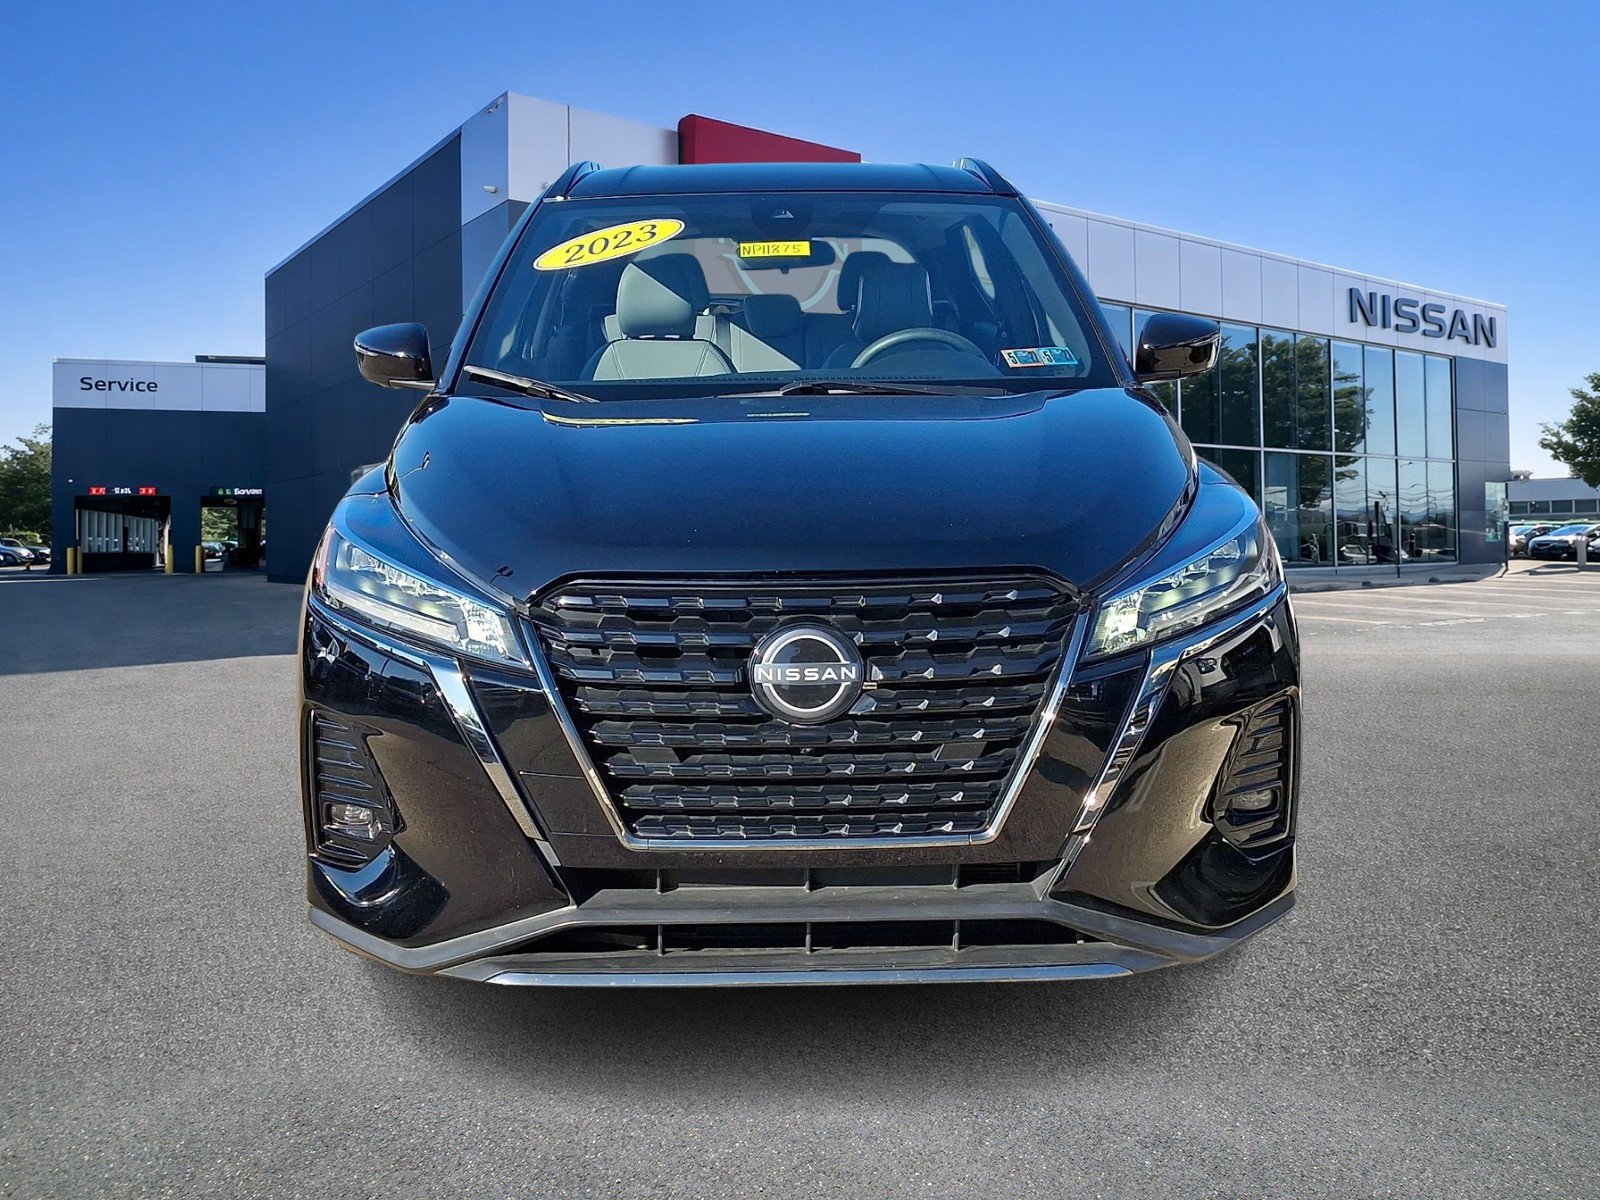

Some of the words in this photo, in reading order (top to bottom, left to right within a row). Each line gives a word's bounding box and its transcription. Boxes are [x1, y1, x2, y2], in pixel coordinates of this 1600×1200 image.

[564, 223, 658, 264] 2023
[1349, 287, 1497, 349] NISSAN
[79, 376, 158, 393] Service
[758, 666, 856, 681] NISSAN
